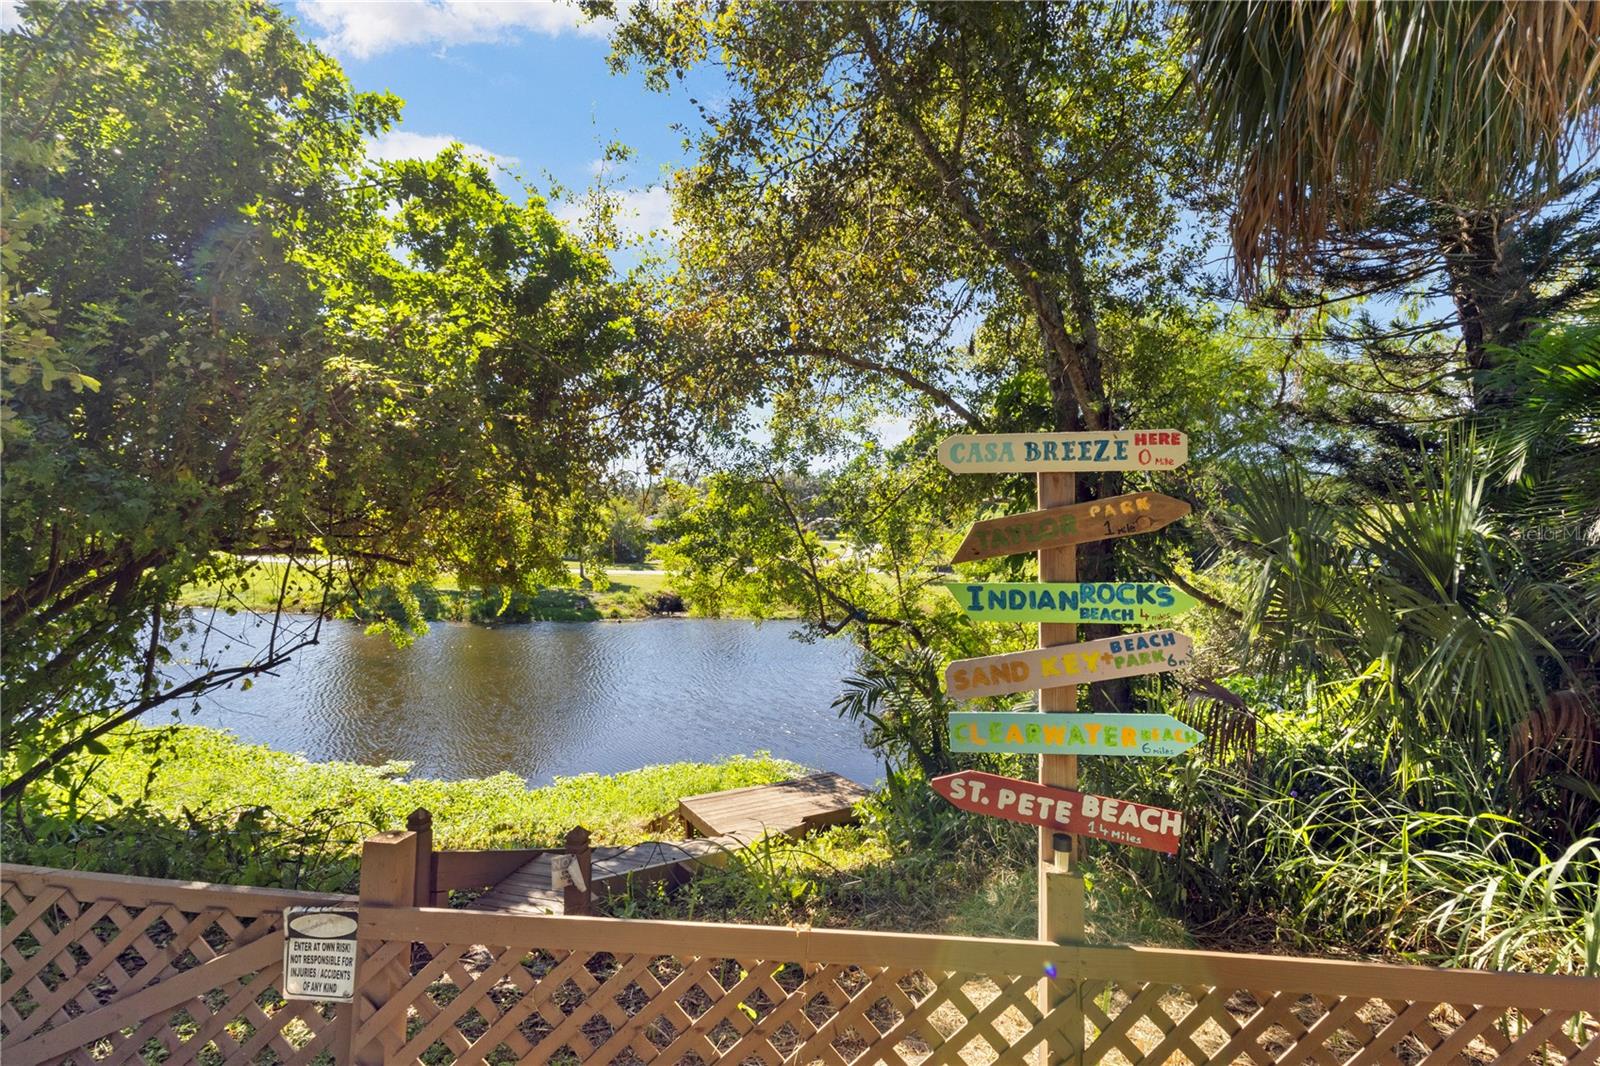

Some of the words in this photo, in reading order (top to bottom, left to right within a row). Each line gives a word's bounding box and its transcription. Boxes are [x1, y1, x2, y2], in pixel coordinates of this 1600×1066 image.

[1134, 433, 1181, 446] HERE
[950, 442, 1015, 464] CASA
[1089, 496, 1151, 518] PARK
[975, 515, 1078, 550] TAYLOR
[1103, 520, 1114, 536] 1
[967, 586, 1078, 611] INDIAN
[1079, 583, 1175, 607] ROCKS
[1080, 607, 1134, 620] BEACH
[1140, 609, 1149, 621] 4
[1109, 633, 1175, 653] BEACH
[1114, 650, 1166, 670] PARK
[1167, 653, 1178, 667] 6
[953, 660, 1030, 691] SAND
[953, 722, 1137, 747] CLEARWATER
[1141, 728, 1197, 743] BEACH
[1142, 743, 1151, 754] 6
[950, 778, 989, 805] ST.
[998, 789, 1073, 824] PETE
[1081, 795, 1182, 836] BEACH
[1088, 822, 1109, 835] 14
[293, 941, 312, 951] ENTER
[313, 942, 321, 951] AT
[322, 942, 335, 952] OWN
[290, 954, 302, 964] NOT
[303, 955, 341, 966] RESPONSIBLE
[341, 956, 353, 967] FOR
[290, 967, 317, 978] INJURIES
[320, 969, 351, 980] ACCIDENTS
[302, 981, 310, 991] OF
[310, 982, 322, 992] ANY
[323, 982, 337, 993] KIND
